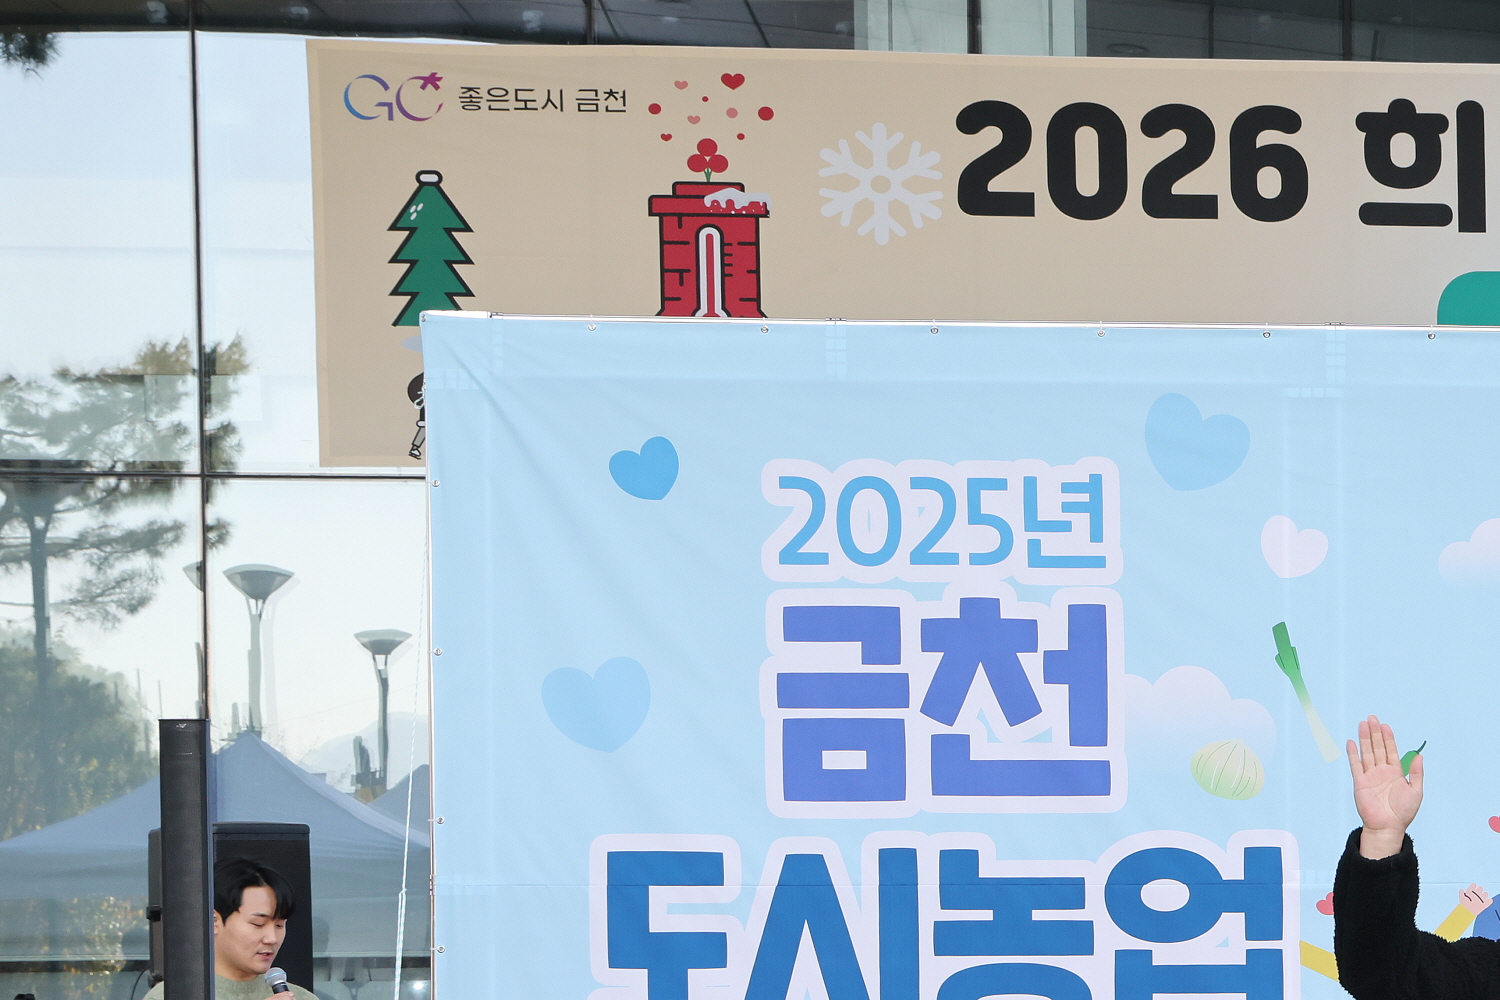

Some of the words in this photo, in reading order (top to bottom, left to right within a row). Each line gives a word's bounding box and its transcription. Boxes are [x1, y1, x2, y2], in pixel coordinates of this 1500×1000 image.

[458, 86, 564, 112] 좋은도시
[575, 88, 627, 113] 금천
[955, 99, 1310, 222] 2026
[777, 473, 1107, 569] 2025년
[776, 596, 1112, 802] 금천
